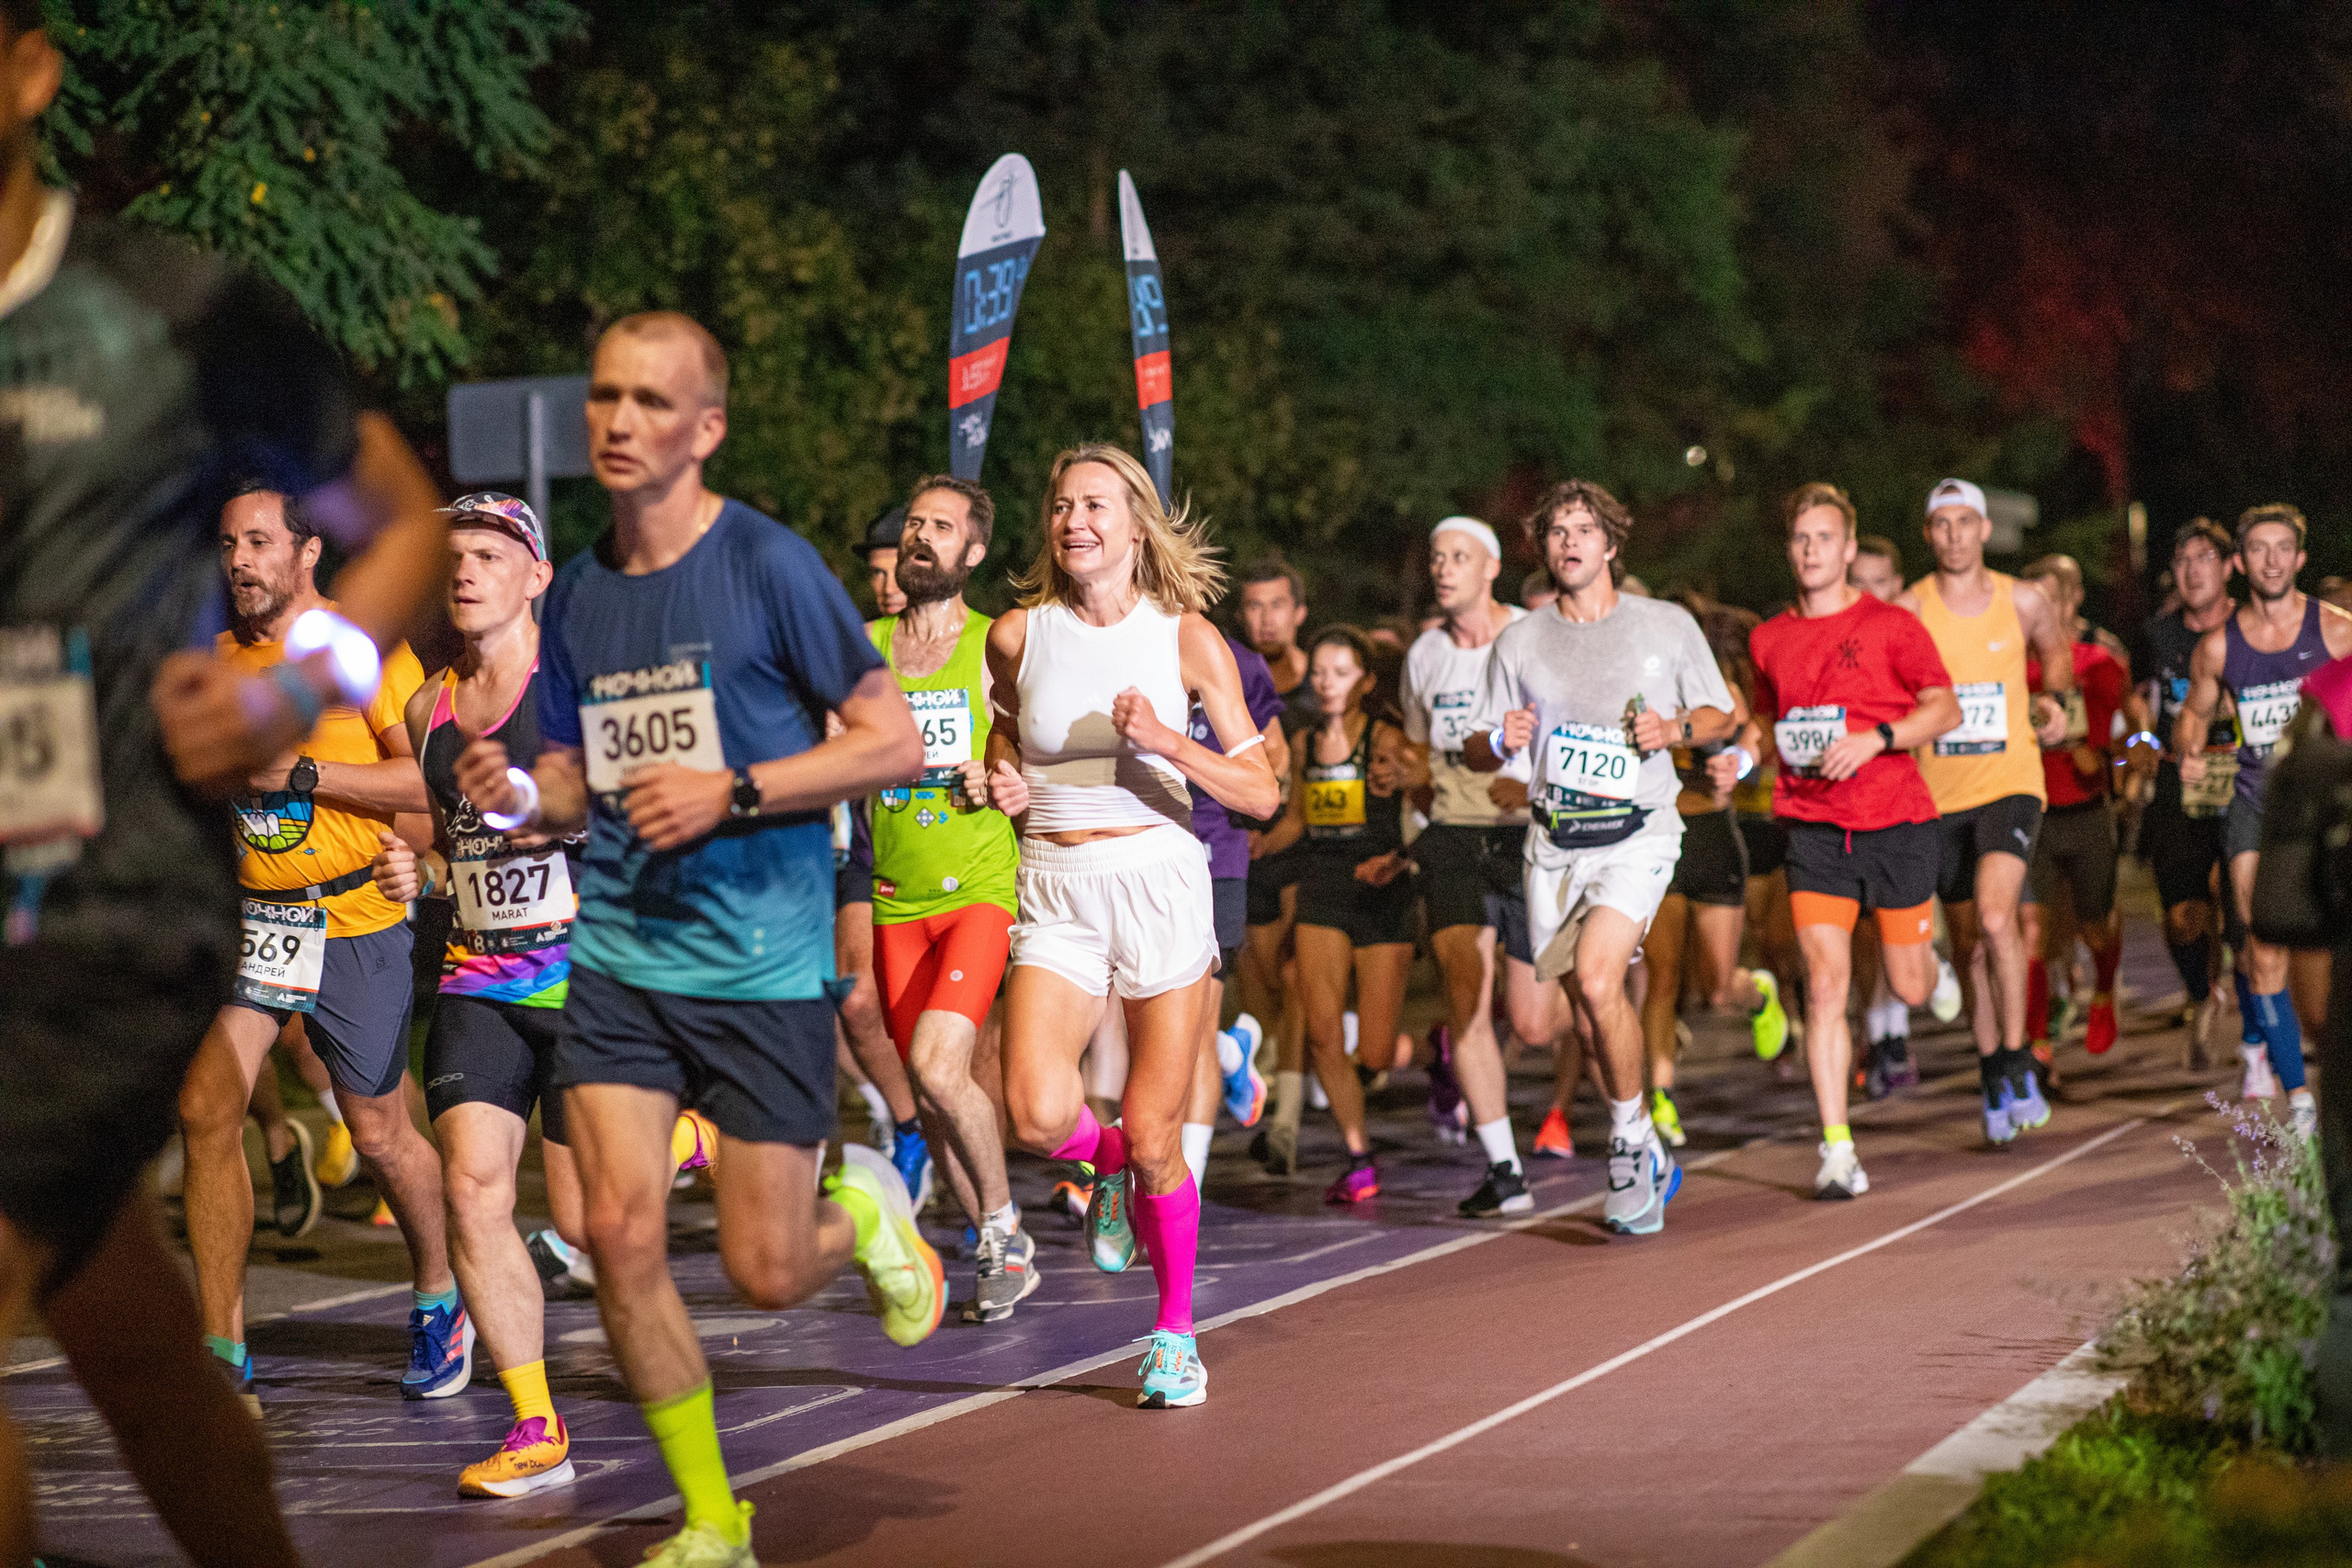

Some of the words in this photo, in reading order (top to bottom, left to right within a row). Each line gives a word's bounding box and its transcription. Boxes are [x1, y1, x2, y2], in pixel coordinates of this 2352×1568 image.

[602, 707, 695, 761] 3605
[1560, 746, 1626, 780] 7120
[468, 863, 551, 908] 1827
[492, 907, 528, 921] MARAT
[241, 961, 286, 978] АНДРЕЙ
